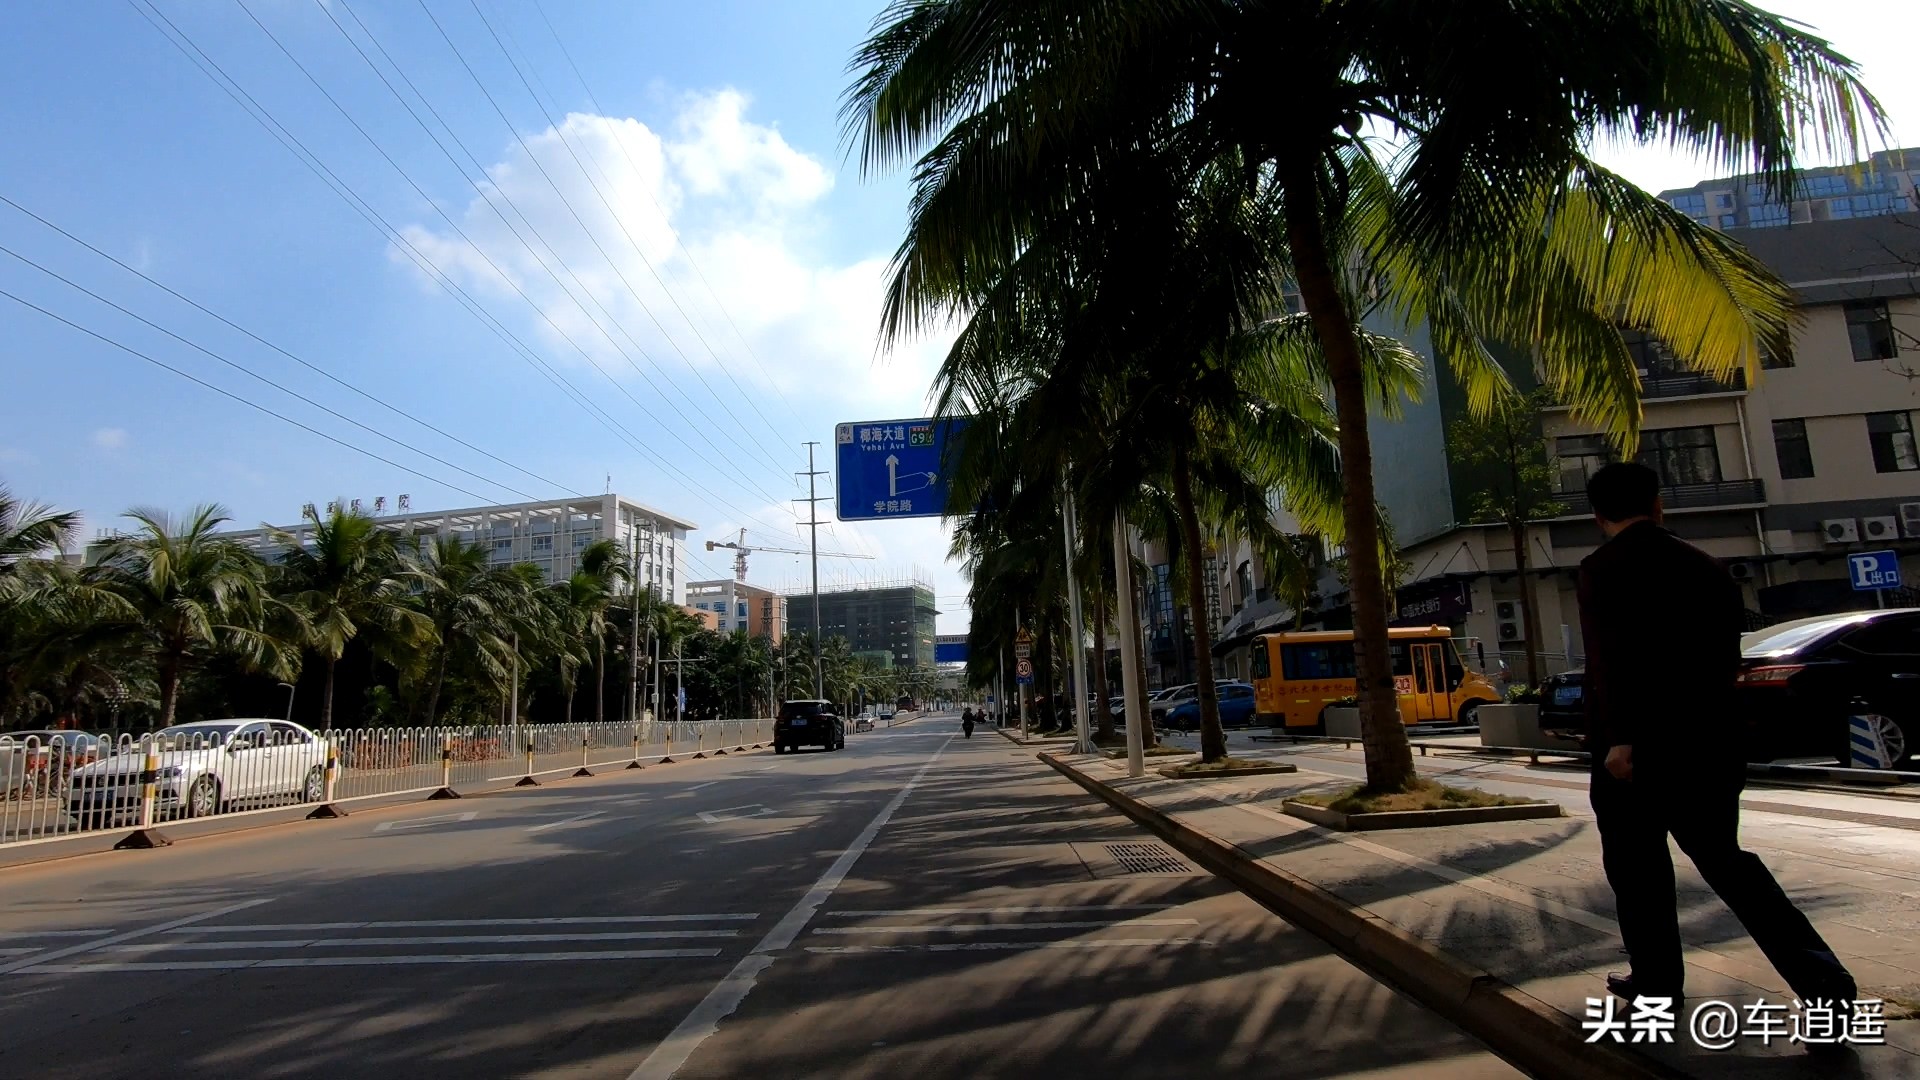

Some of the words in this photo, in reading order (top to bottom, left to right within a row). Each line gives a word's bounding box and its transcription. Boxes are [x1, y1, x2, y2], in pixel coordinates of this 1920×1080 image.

[860, 425, 906, 442] 椰海大道
[861, 443, 886, 452] Yehai
[889, 442, 905, 450] Ave
[873, 500, 912, 513] 学院路
[1851, 556, 1878, 587] P
[1871, 570, 1898, 585] 出口
[1019, 663, 1029, 673] 30
